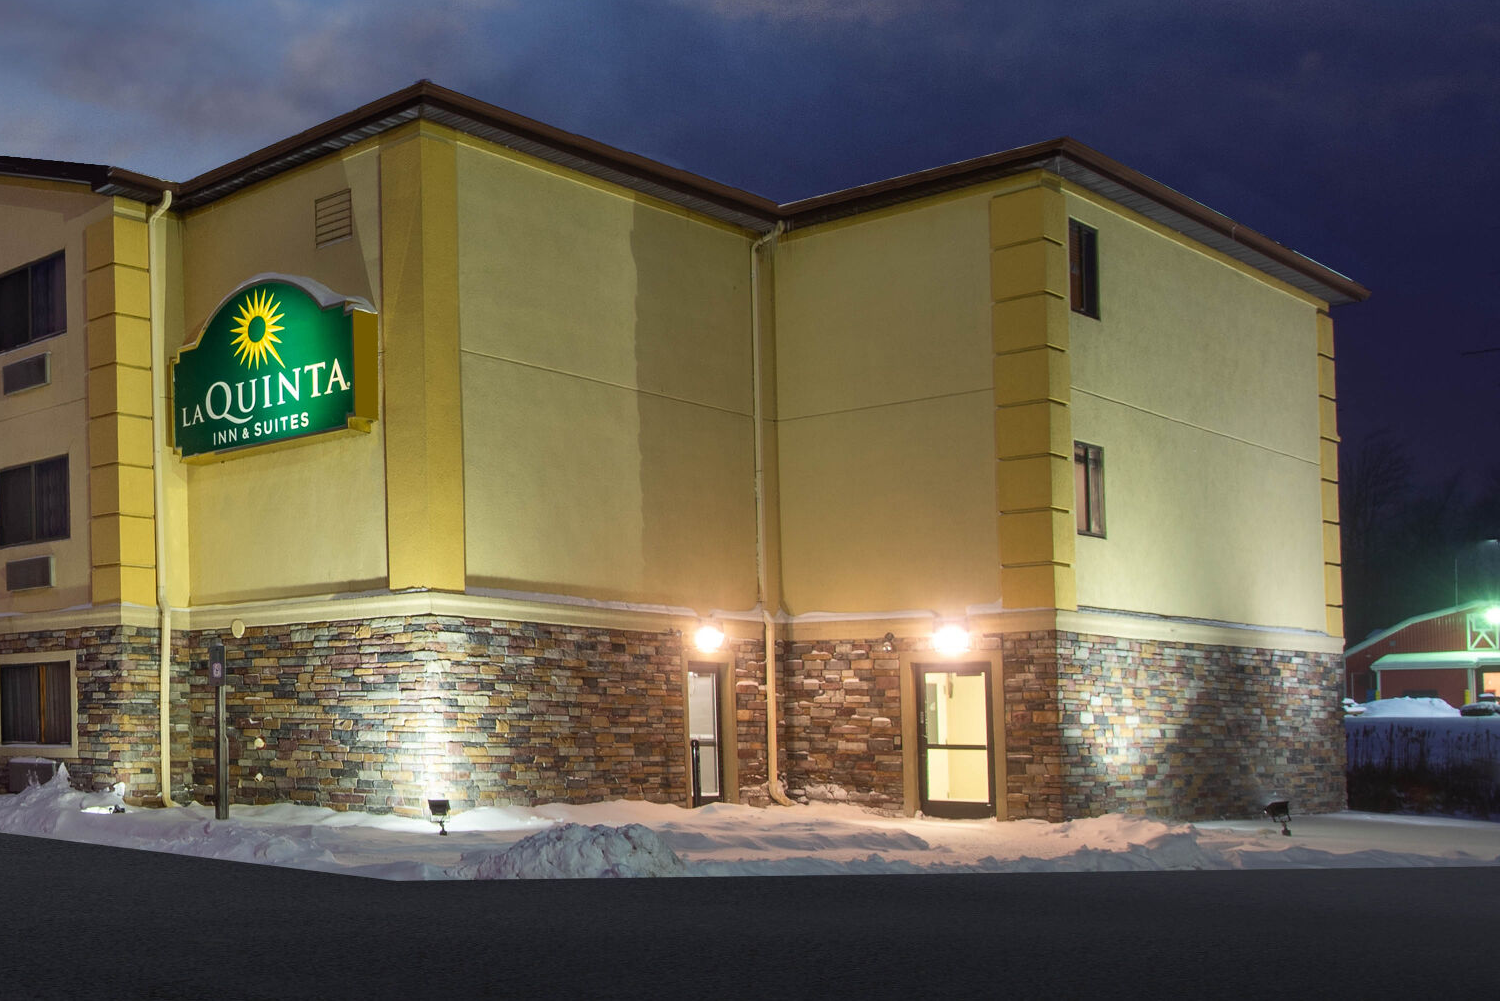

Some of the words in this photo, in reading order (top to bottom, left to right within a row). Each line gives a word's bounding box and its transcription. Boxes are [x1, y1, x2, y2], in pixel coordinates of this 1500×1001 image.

[182, 404, 204, 427] LA
[213, 427, 238, 446] INN
[242, 427, 250, 439] &
[254, 411, 309, 436] SUITES
